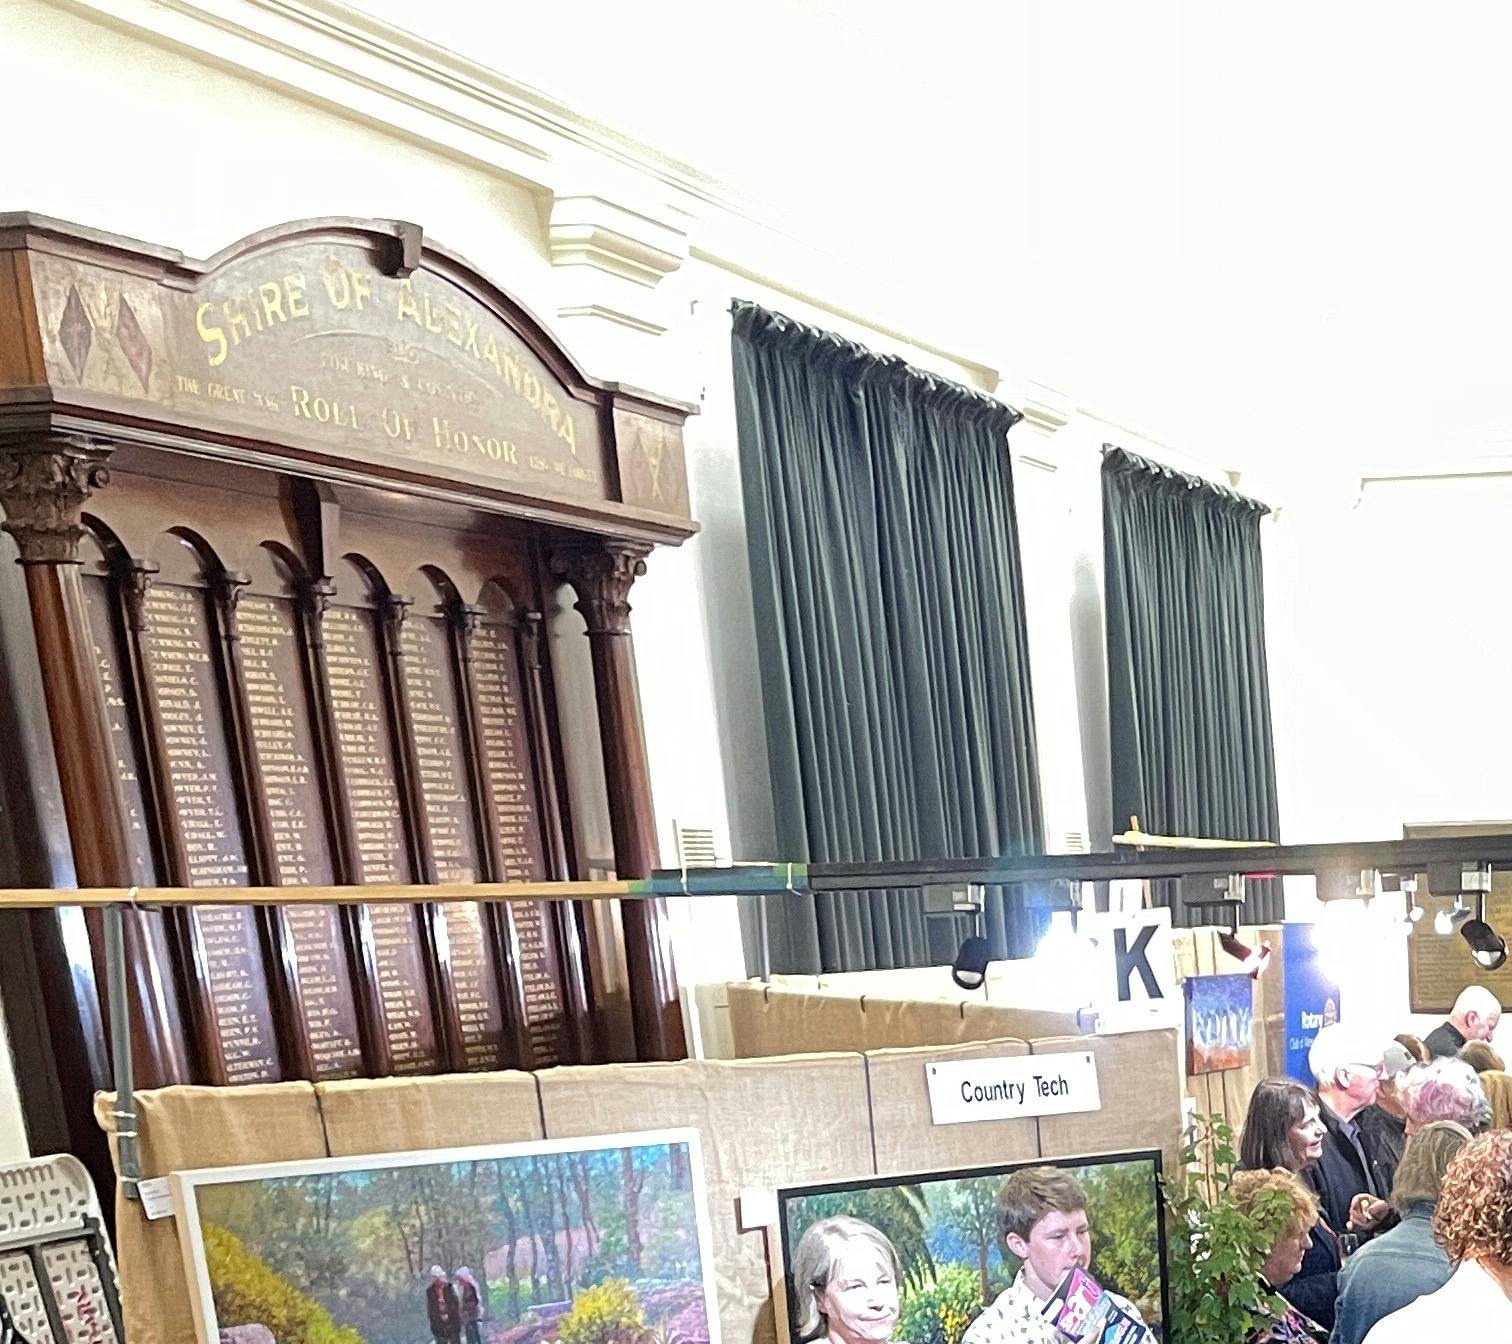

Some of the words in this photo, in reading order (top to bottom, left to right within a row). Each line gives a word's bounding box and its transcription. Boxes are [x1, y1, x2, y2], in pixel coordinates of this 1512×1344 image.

[196, 273, 310, 366] SHIRE
[322, 262, 371, 311] OF
[398, 278, 576, 455] ALEXANDRA
[290, 385, 364, 430] ROLL
[432, 416, 519, 465] HONOR
[1113, 924, 1165, 1002] K
[961, 1079, 1025, 1105] Country
[1033, 1073, 1069, 1098] Tech
